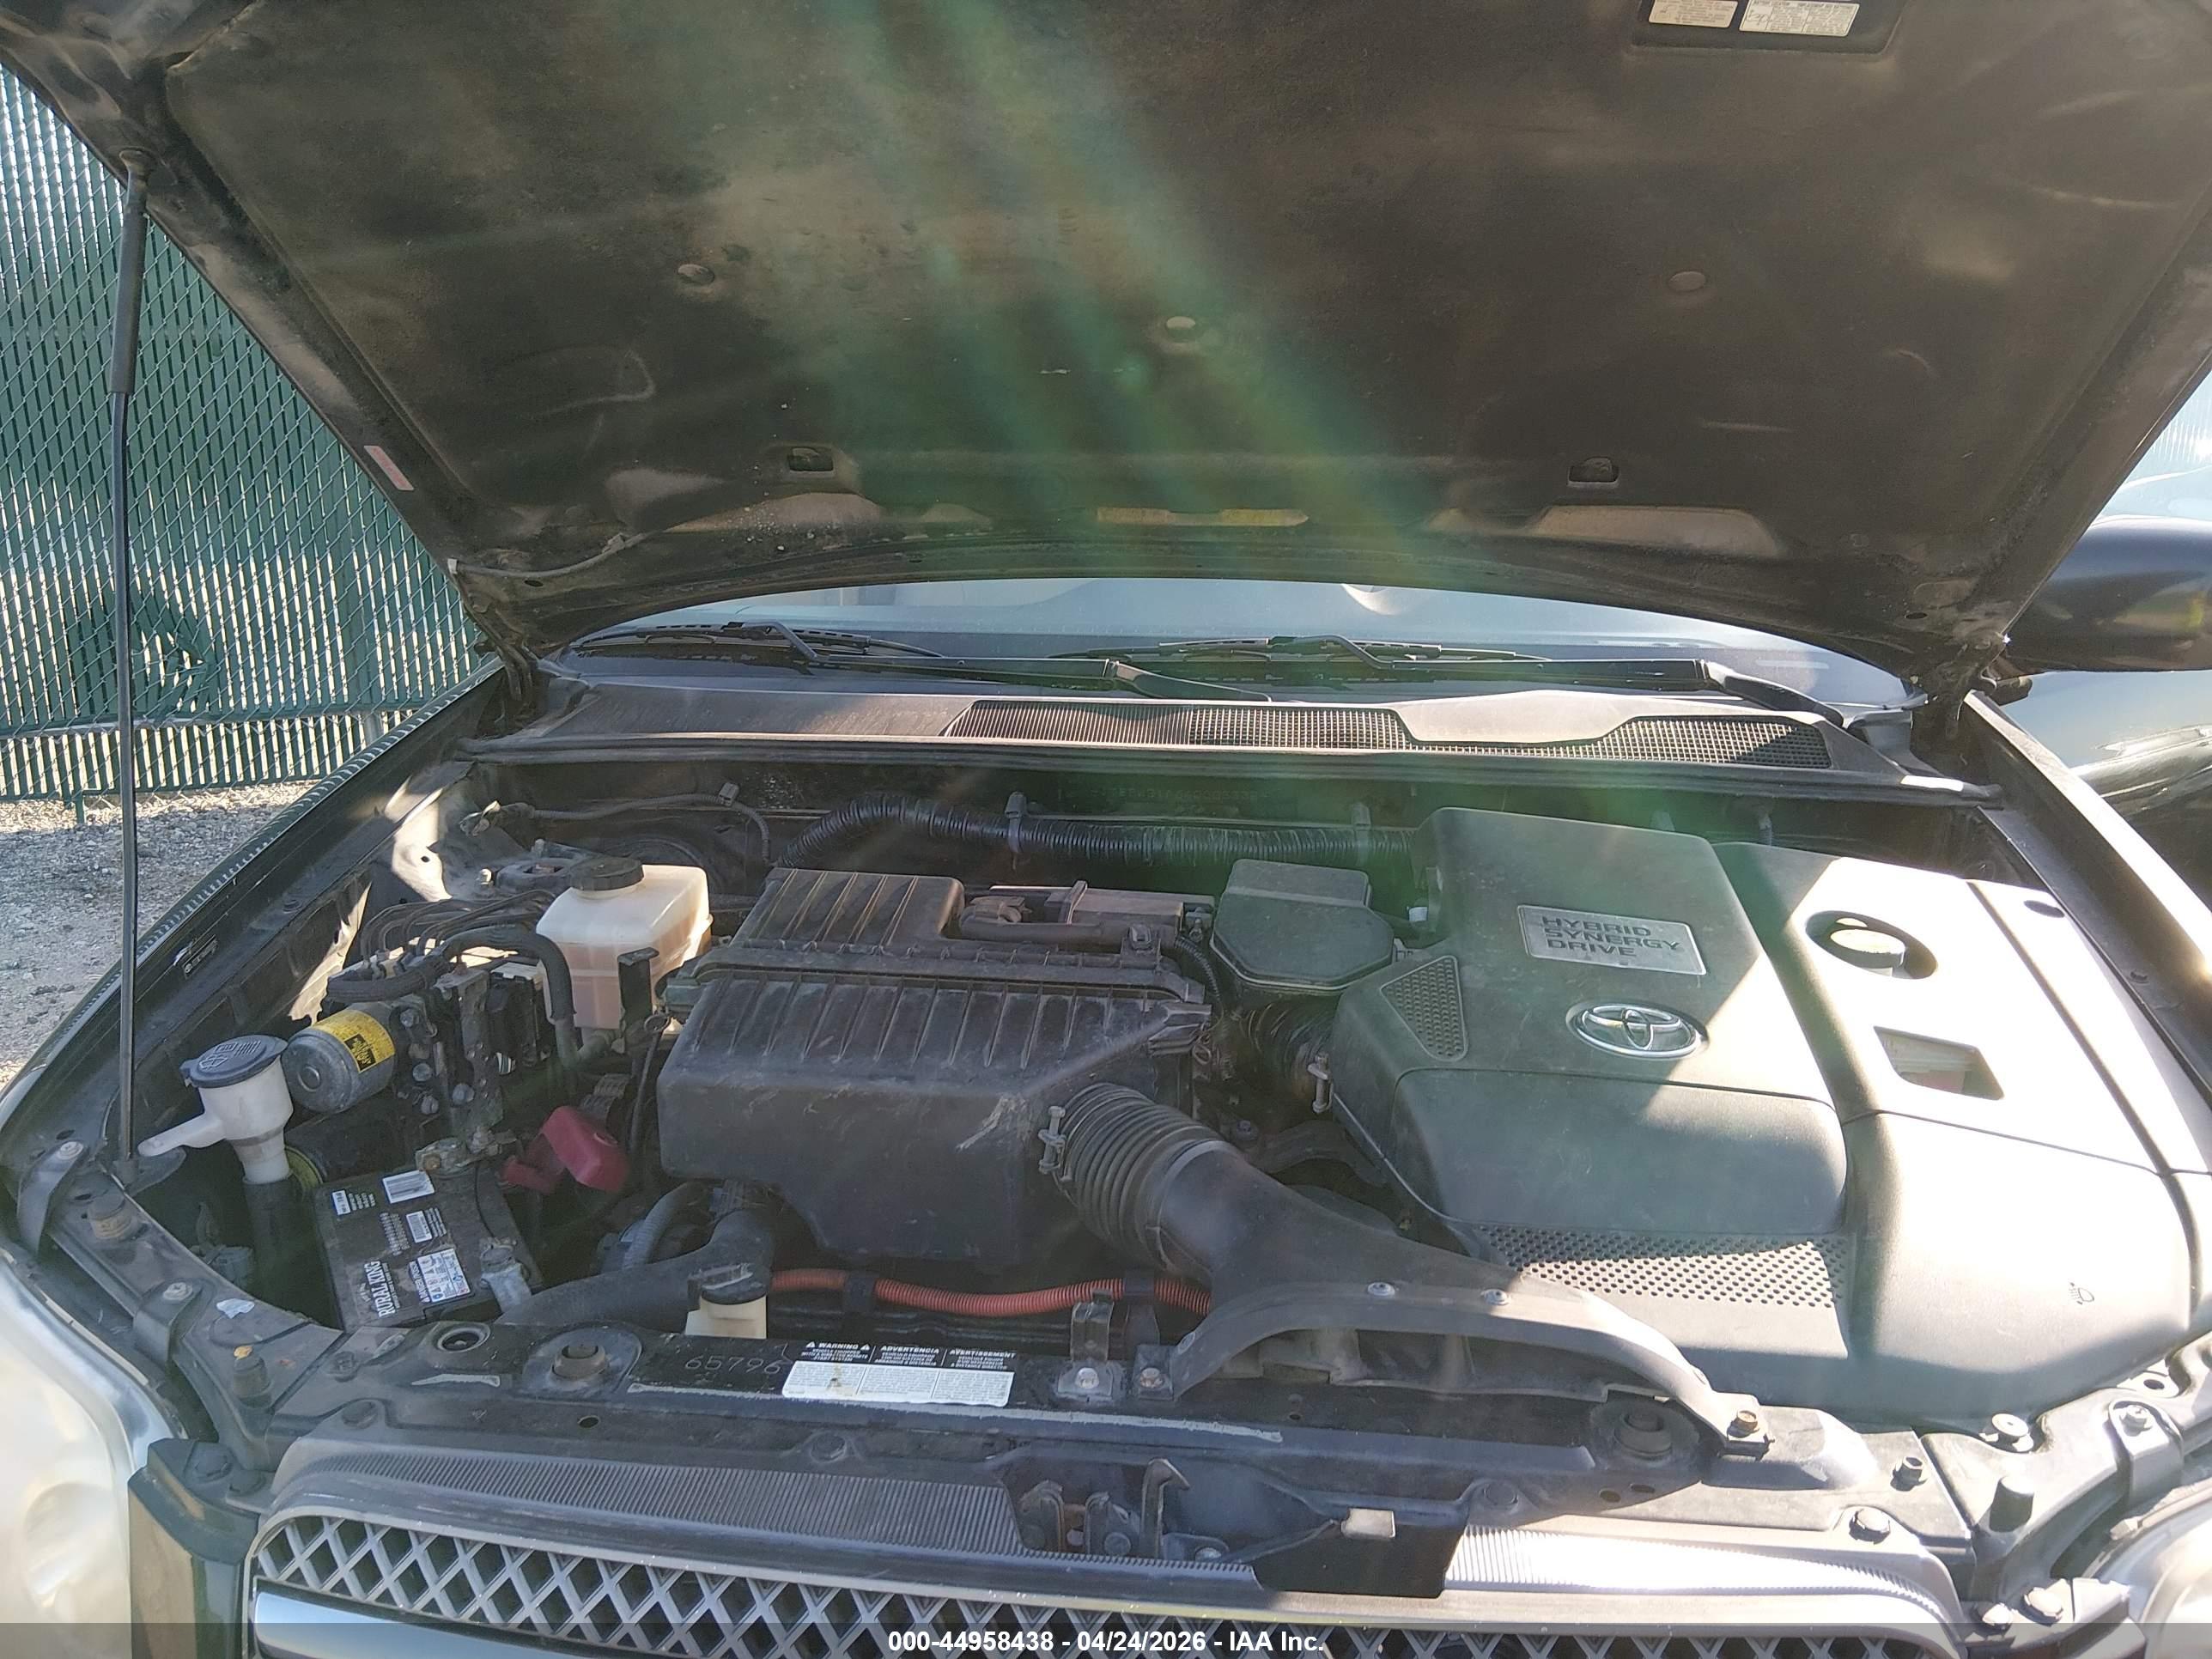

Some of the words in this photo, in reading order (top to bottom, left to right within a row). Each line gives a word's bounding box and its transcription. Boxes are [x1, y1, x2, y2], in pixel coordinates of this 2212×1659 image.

[1542, 916, 1651, 937] HYBRID
[1545, 927, 1680, 951] SYNERGY
[1547, 939, 1637, 957] DRIVE
[363, 1261, 386, 1285] KING
[371, 1283, 396, 1317] RURAL
[881, 1346, 939, 1354] ADVERTENCIA
[949, 1348, 1017, 1358] AVERTISSEMENT
